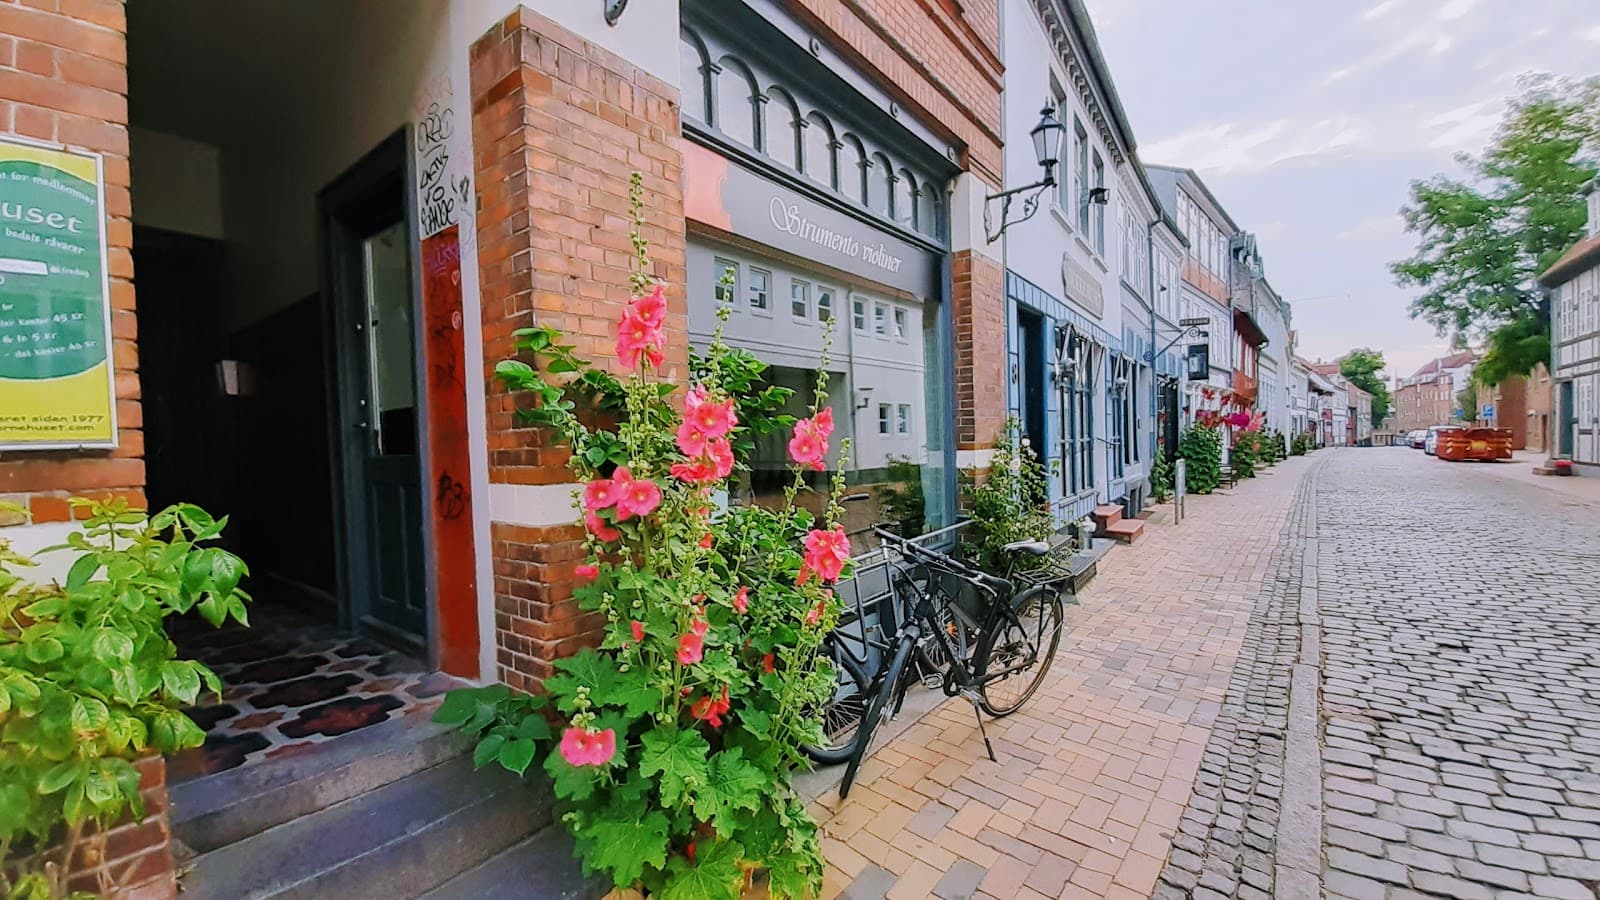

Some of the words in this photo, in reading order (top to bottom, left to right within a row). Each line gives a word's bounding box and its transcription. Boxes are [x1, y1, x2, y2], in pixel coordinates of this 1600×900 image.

[769, 196, 859, 257] Strumento
[862, 243, 902, 273] violiner
[72, 415, 104, 423] 1977
